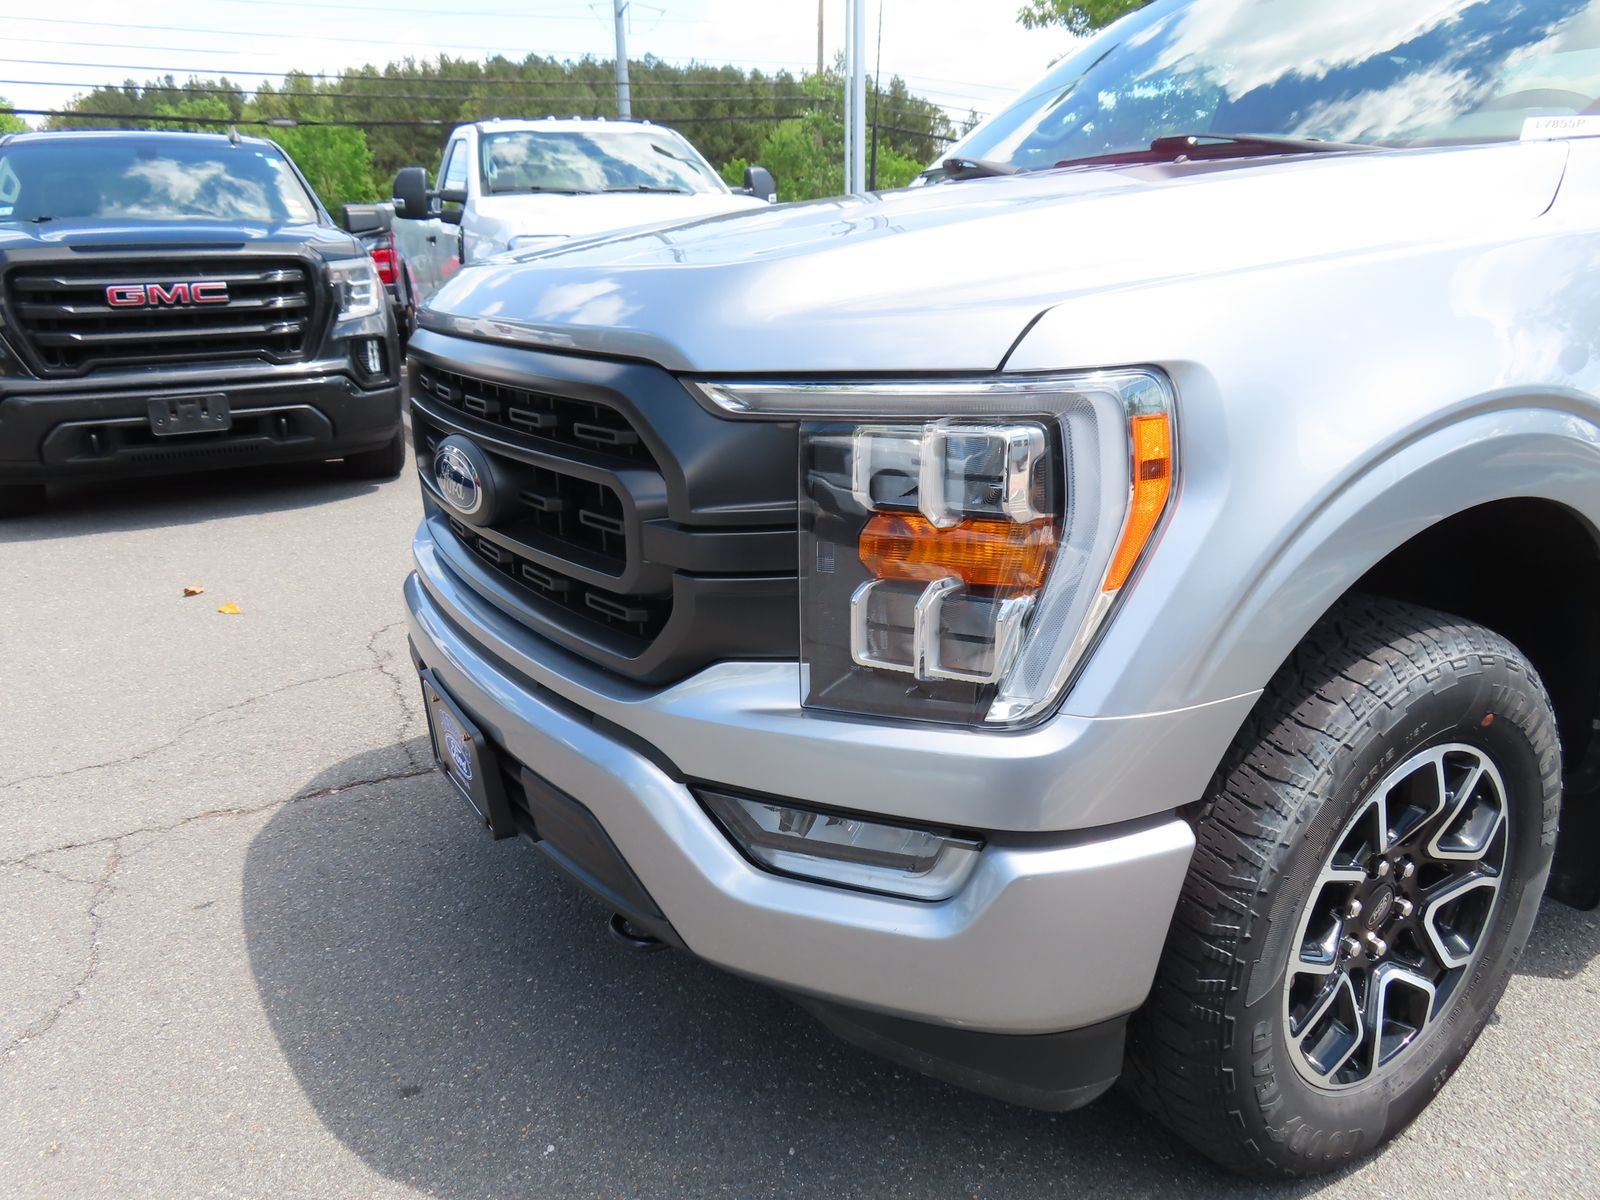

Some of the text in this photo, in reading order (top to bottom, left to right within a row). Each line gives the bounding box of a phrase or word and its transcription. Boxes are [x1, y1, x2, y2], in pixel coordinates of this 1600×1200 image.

[106, 281, 229, 306] GMC
[439, 456, 470, 502] Ford
[1491, 683, 1560, 848] WRANGLER
[1252, 1019, 1365, 1160] GOODYEAR
